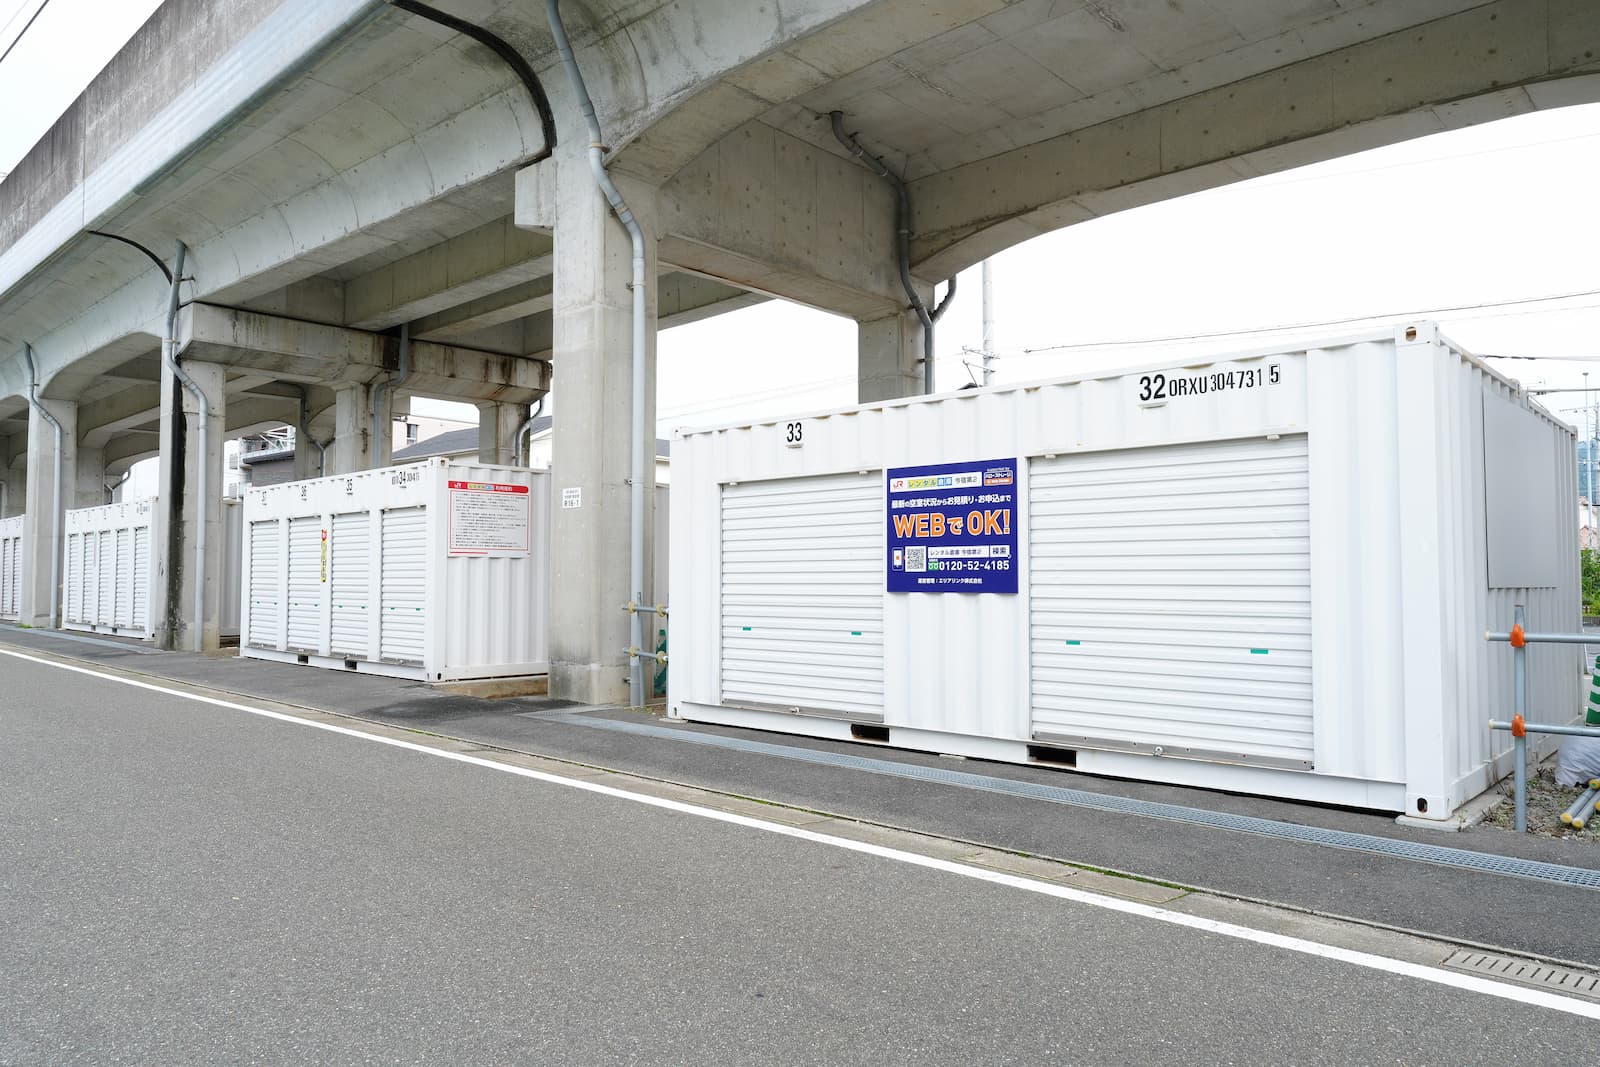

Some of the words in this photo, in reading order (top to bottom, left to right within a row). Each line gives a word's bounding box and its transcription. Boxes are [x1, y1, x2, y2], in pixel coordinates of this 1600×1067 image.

[1139, 374, 1166, 401] 32
[1169, 375, 1208, 396] ORXU
[786, 422, 802, 442] 33
[939, 560, 1010, 571] 0120-52-4185
